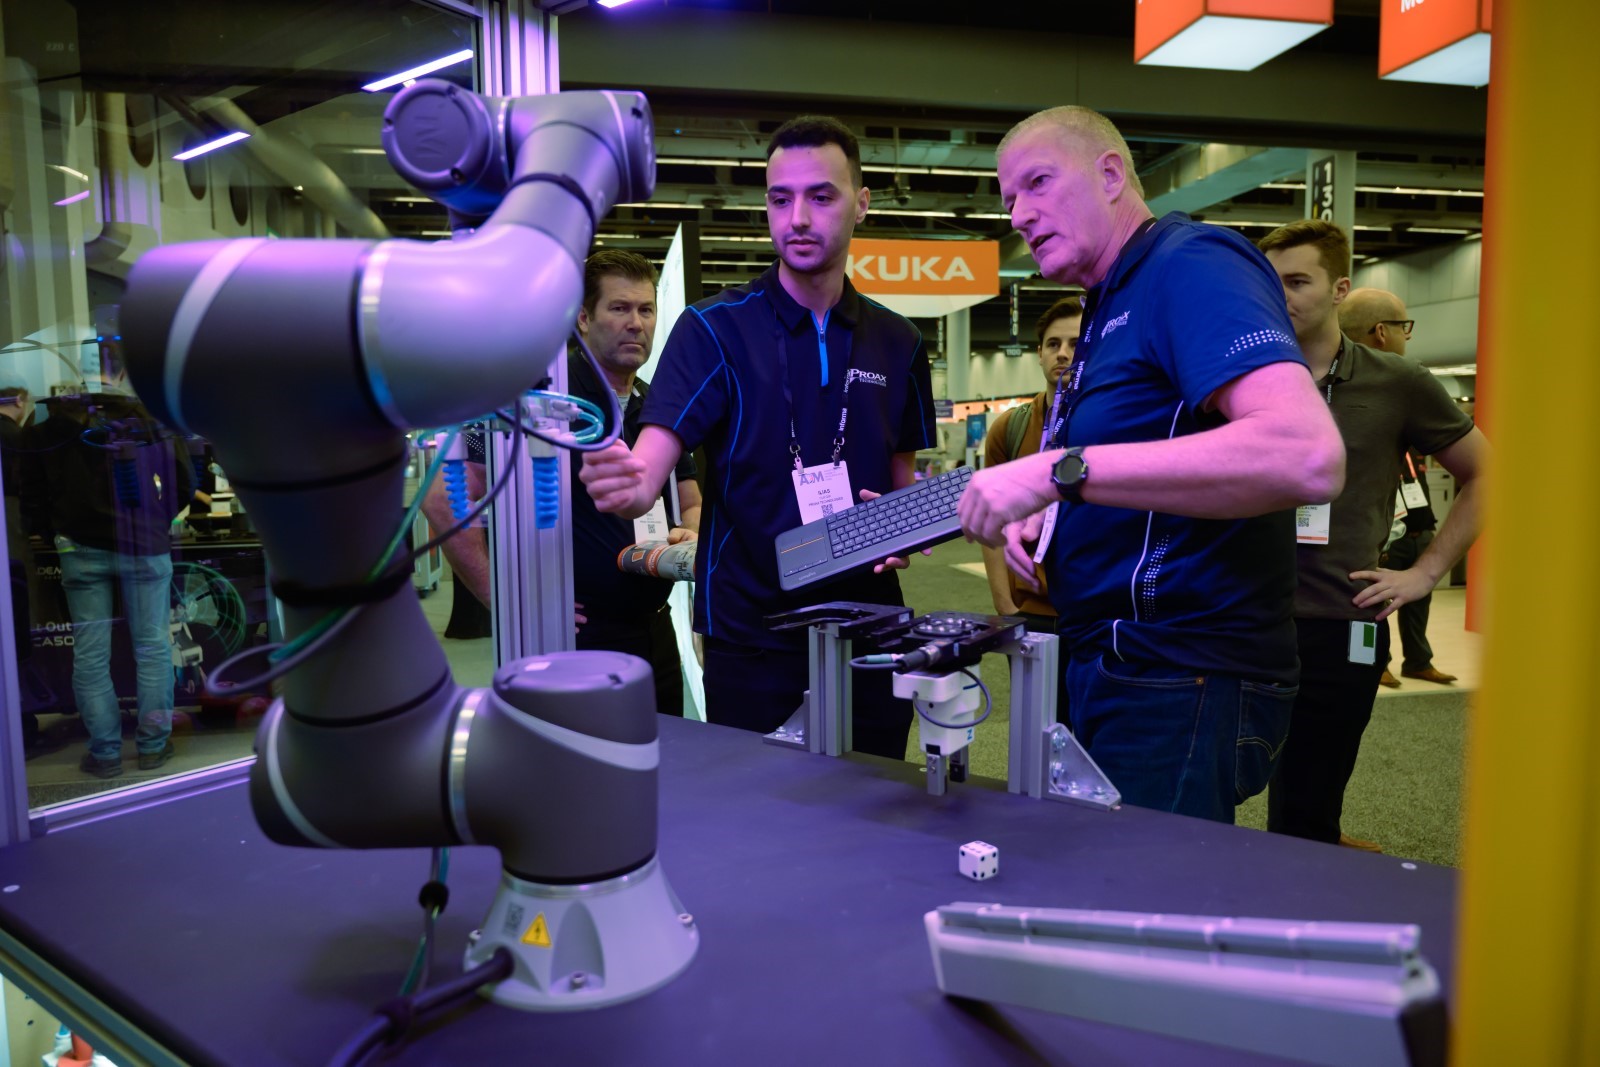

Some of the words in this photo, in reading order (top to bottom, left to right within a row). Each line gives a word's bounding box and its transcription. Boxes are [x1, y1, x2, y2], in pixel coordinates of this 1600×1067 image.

[846, 255, 975, 281] KUKA
[1073, 361, 1085, 390] Informa
[838, 408, 848, 432] Informa
[46, 622, 73, 632] Out
